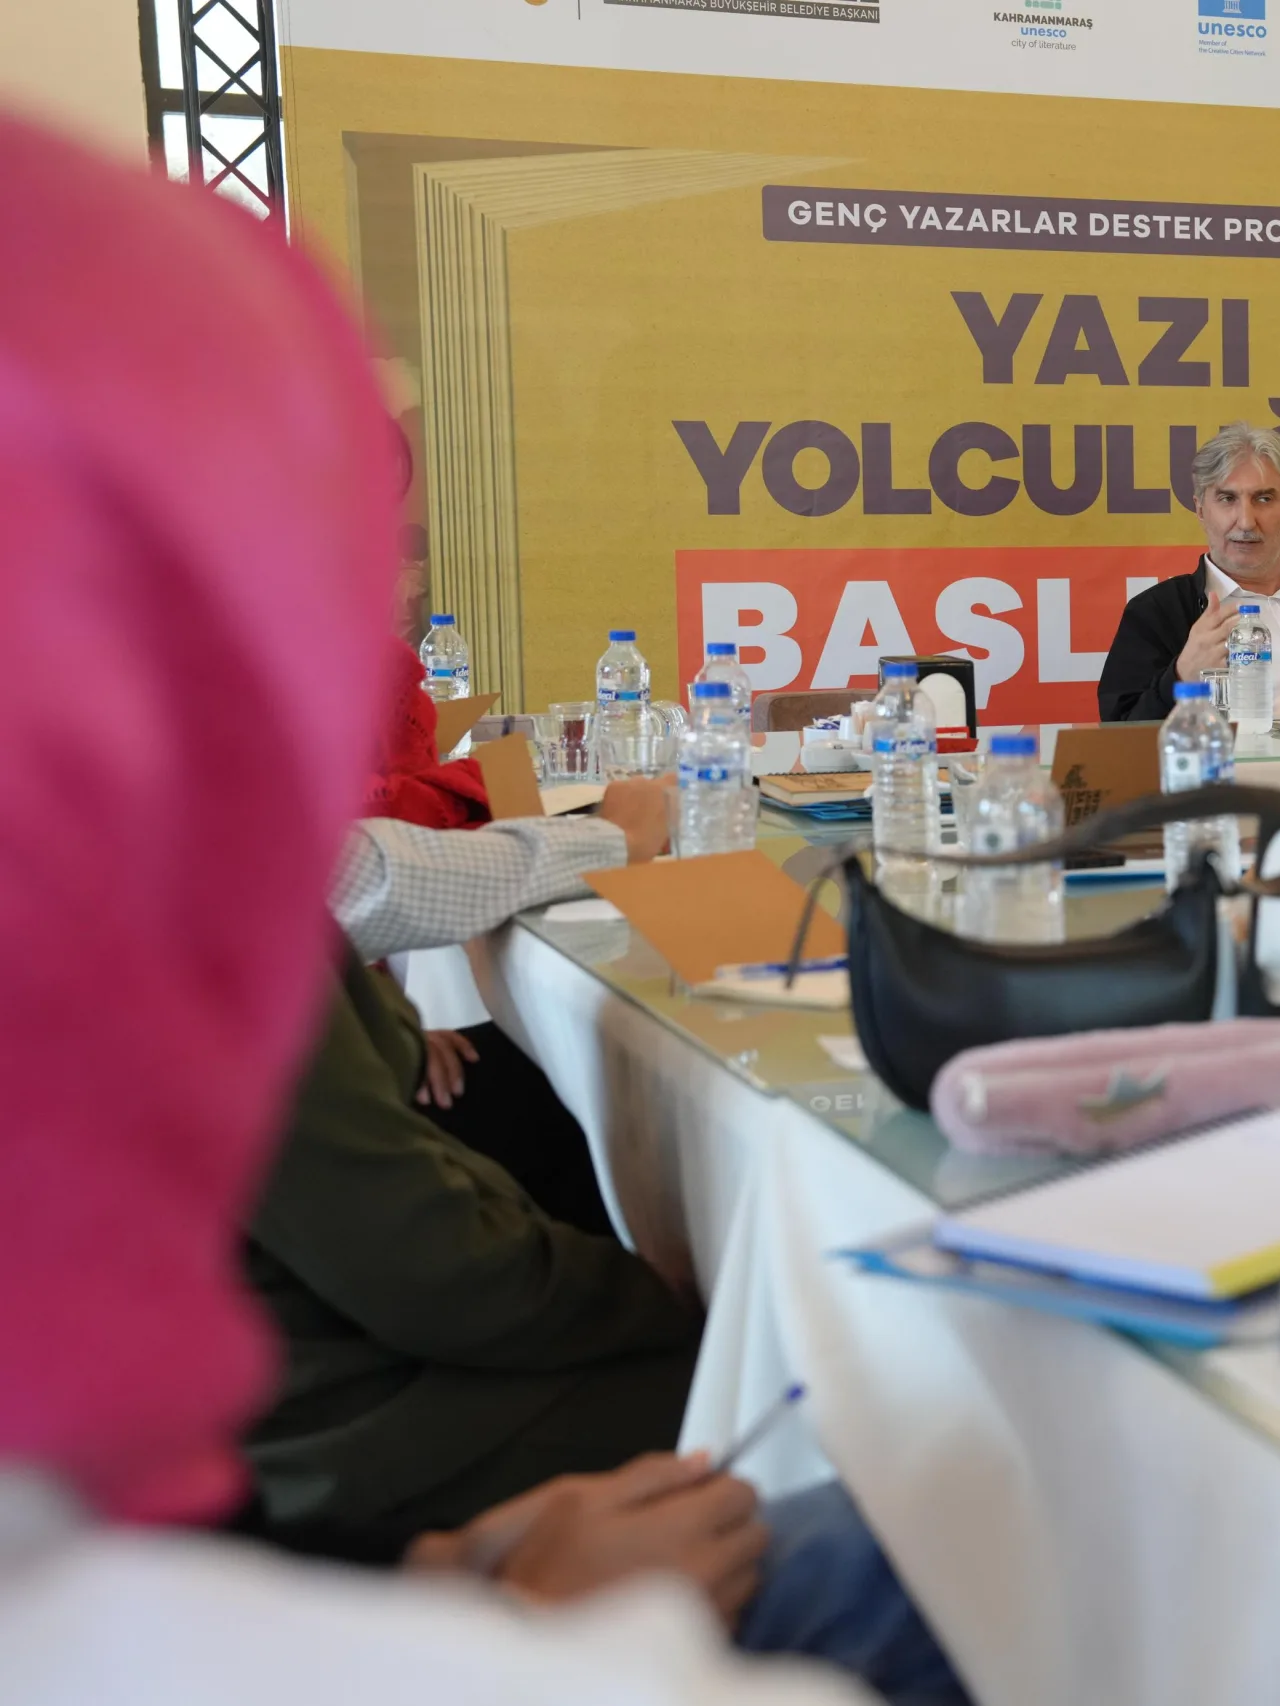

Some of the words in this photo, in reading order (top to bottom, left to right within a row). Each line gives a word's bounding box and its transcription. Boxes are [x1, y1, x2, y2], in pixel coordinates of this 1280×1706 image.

[780, 4, 830, 16] BELEDİYE
[832, 7, 878, 20] BAŞKANI
[993, 12, 1093, 30] KAHRAMANMARAŞ
[1020, 27, 1067, 38] unesco
[1198, 22, 1267, 38] unesco
[1011, 39, 1027, 49] city
[1028, 39, 1038, 48] of
[1039, 40, 1076, 51] literature
[787, 200, 887, 234] GENÇ
[899, 205, 1078, 236] YAZARLAR
[1089, 212, 1214, 241] DESTEK
[950, 290, 1250, 388] YAZI
[1235, 651, 1258, 661] ideal
